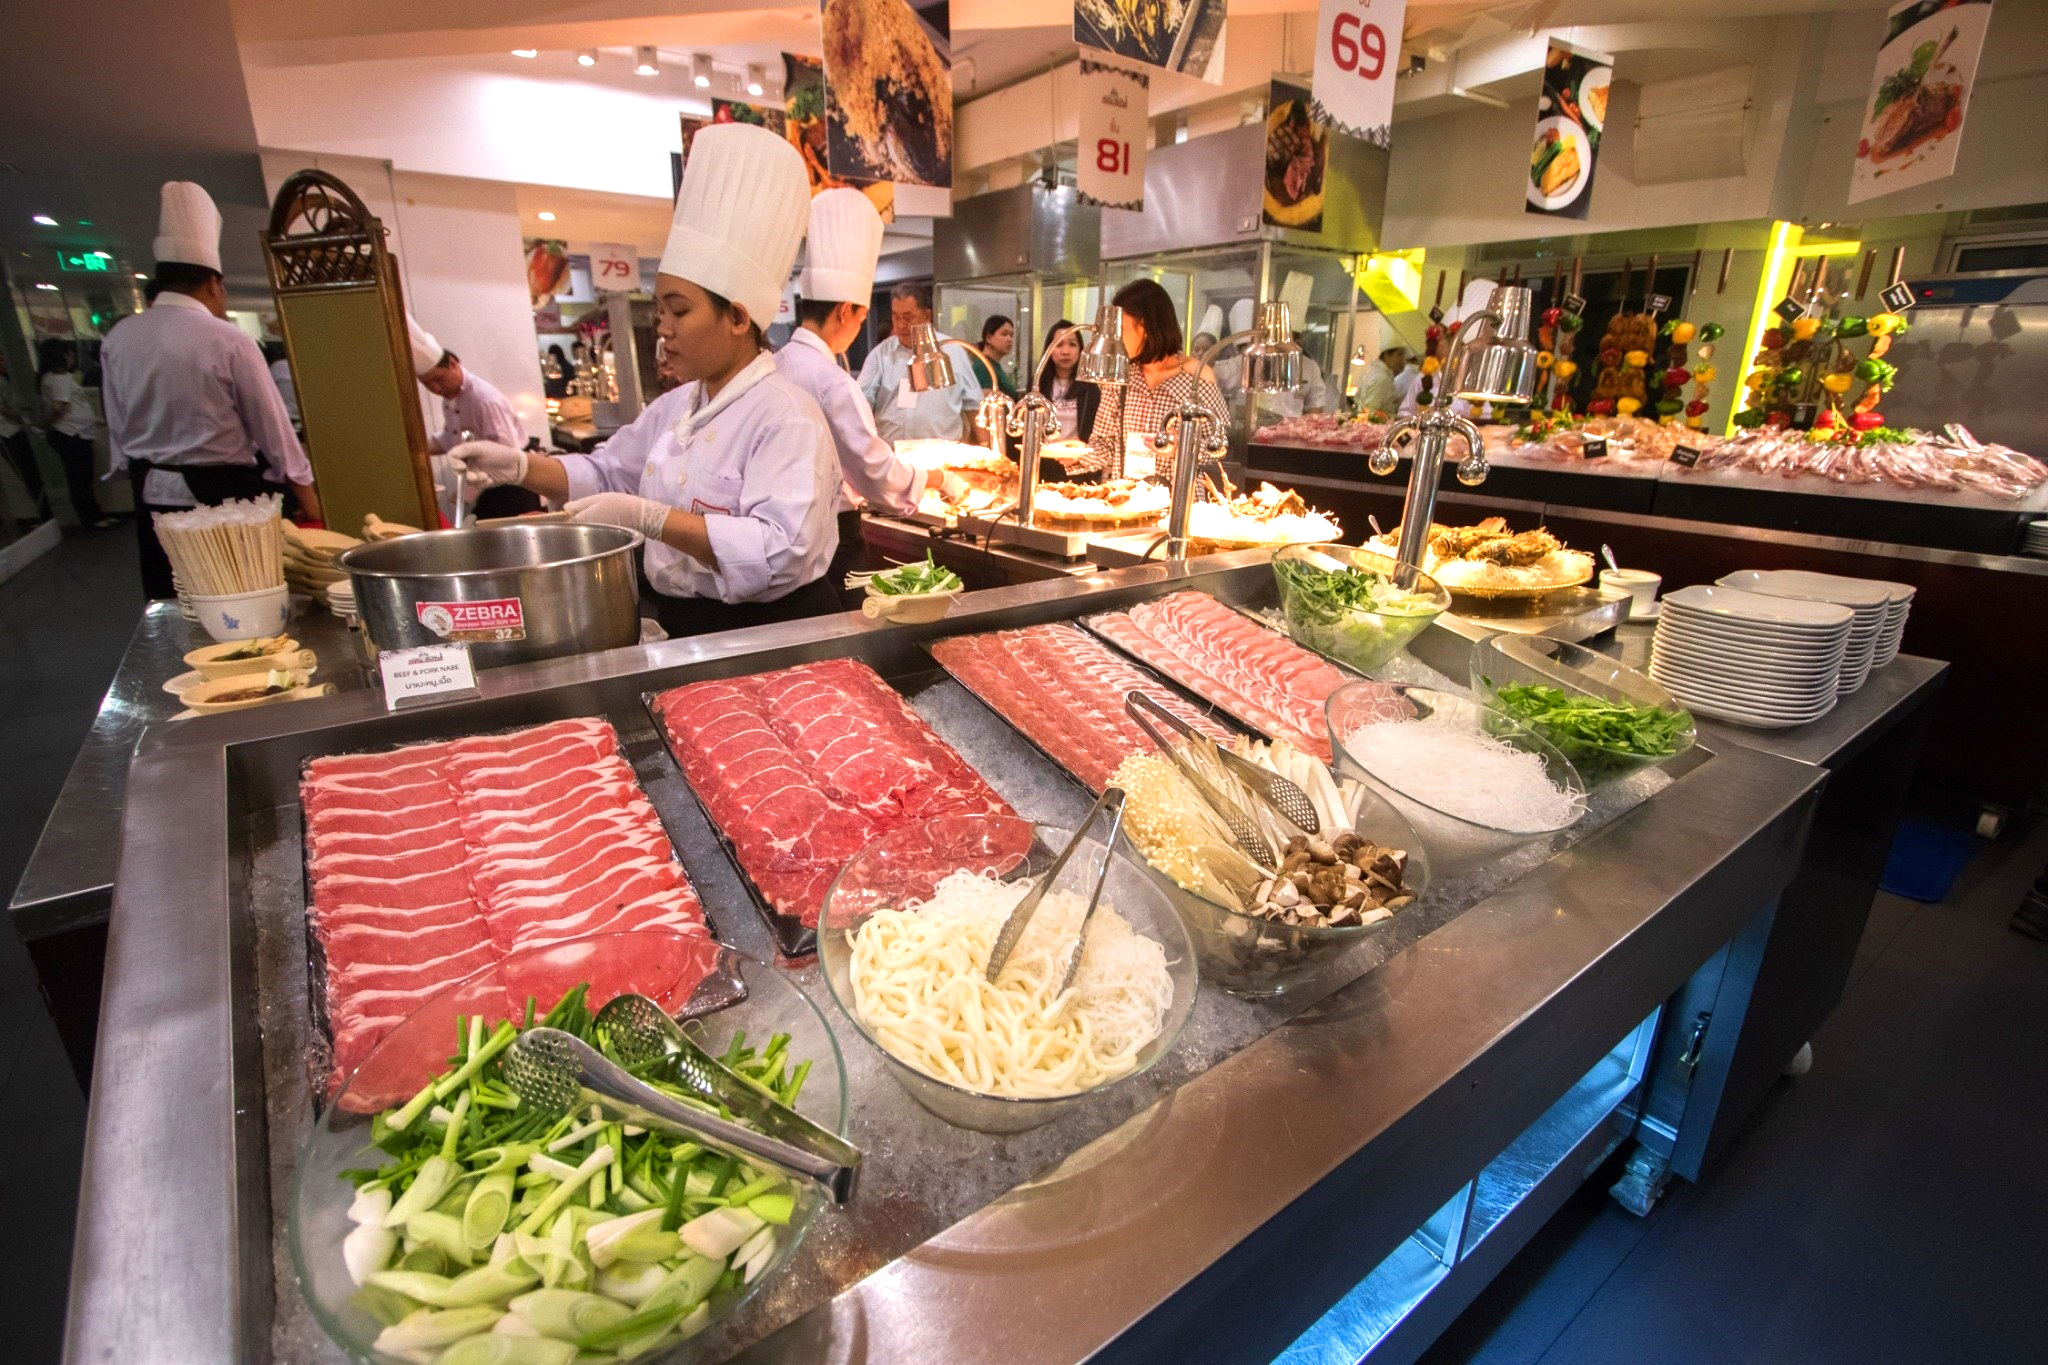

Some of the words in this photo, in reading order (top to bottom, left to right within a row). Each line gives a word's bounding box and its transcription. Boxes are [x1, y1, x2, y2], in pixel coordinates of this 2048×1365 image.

[1331, 11, 1387, 81] 69
[1096, 138, 1130, 176] 81
[598, 259, 630, 277] 79
[453, 604, 518, 621] ZEBRA
[495, 628, 513, 639] 32
[393, 670, 411, 679] BEEF
[419, 666, 439, 675] PORK
[440, 664, 460, 672] NABE
